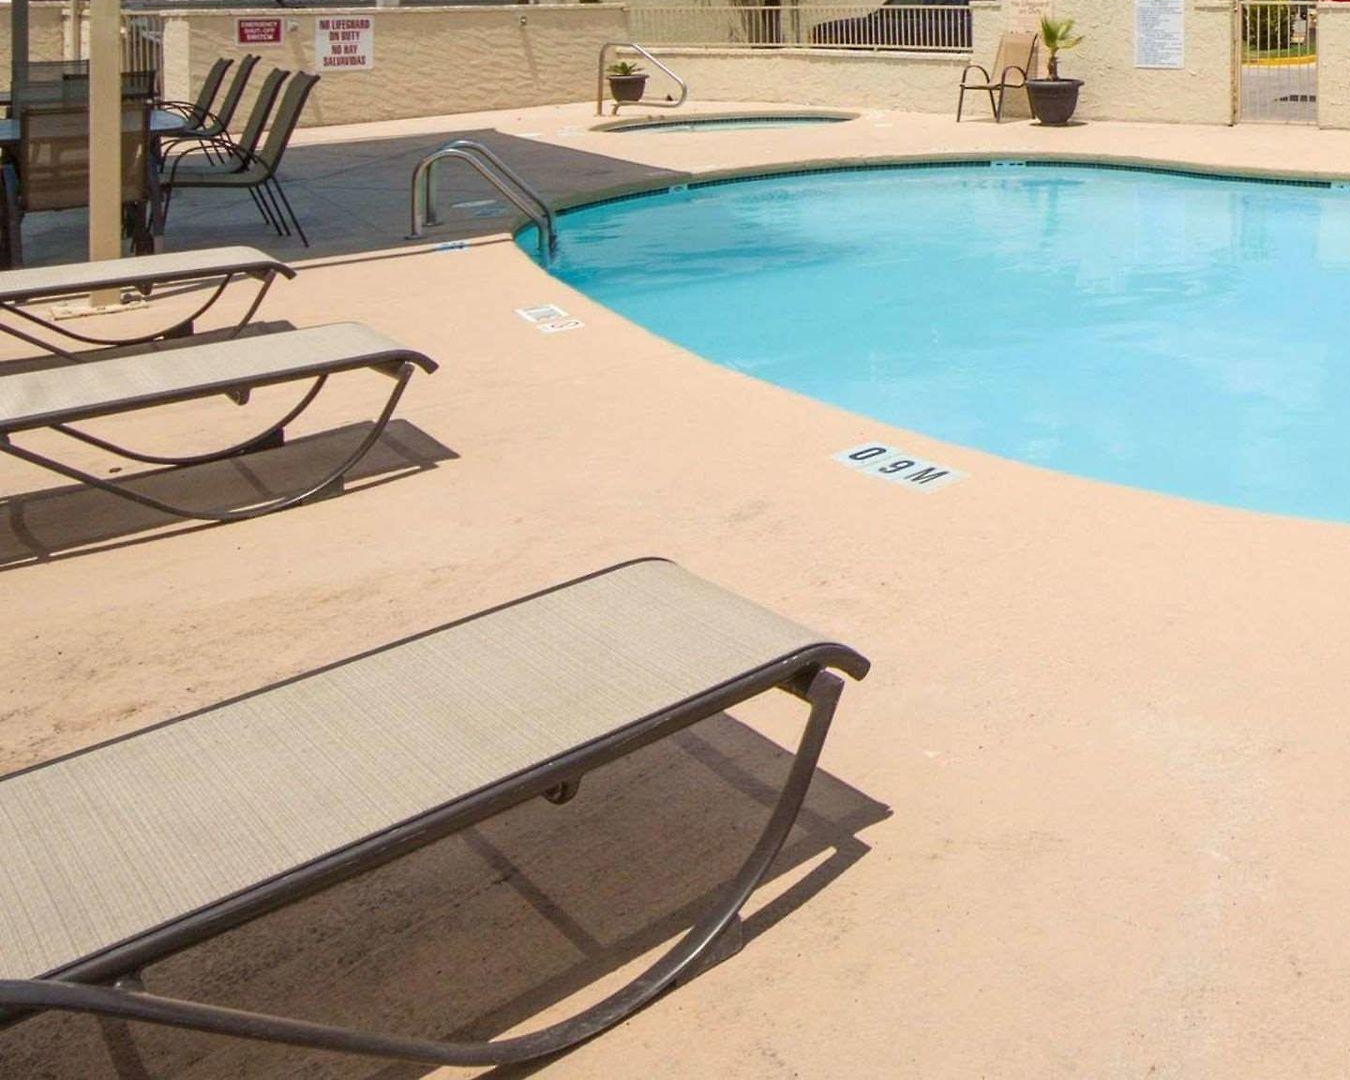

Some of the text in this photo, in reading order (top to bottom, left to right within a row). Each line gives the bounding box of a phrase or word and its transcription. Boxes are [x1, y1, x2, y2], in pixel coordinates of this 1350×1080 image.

[319, 19, 370, 30] NO LIFEGUARD
[329, 31, 360, 41] ON DUTY
[331, 44, 358, 54] NO HAY
